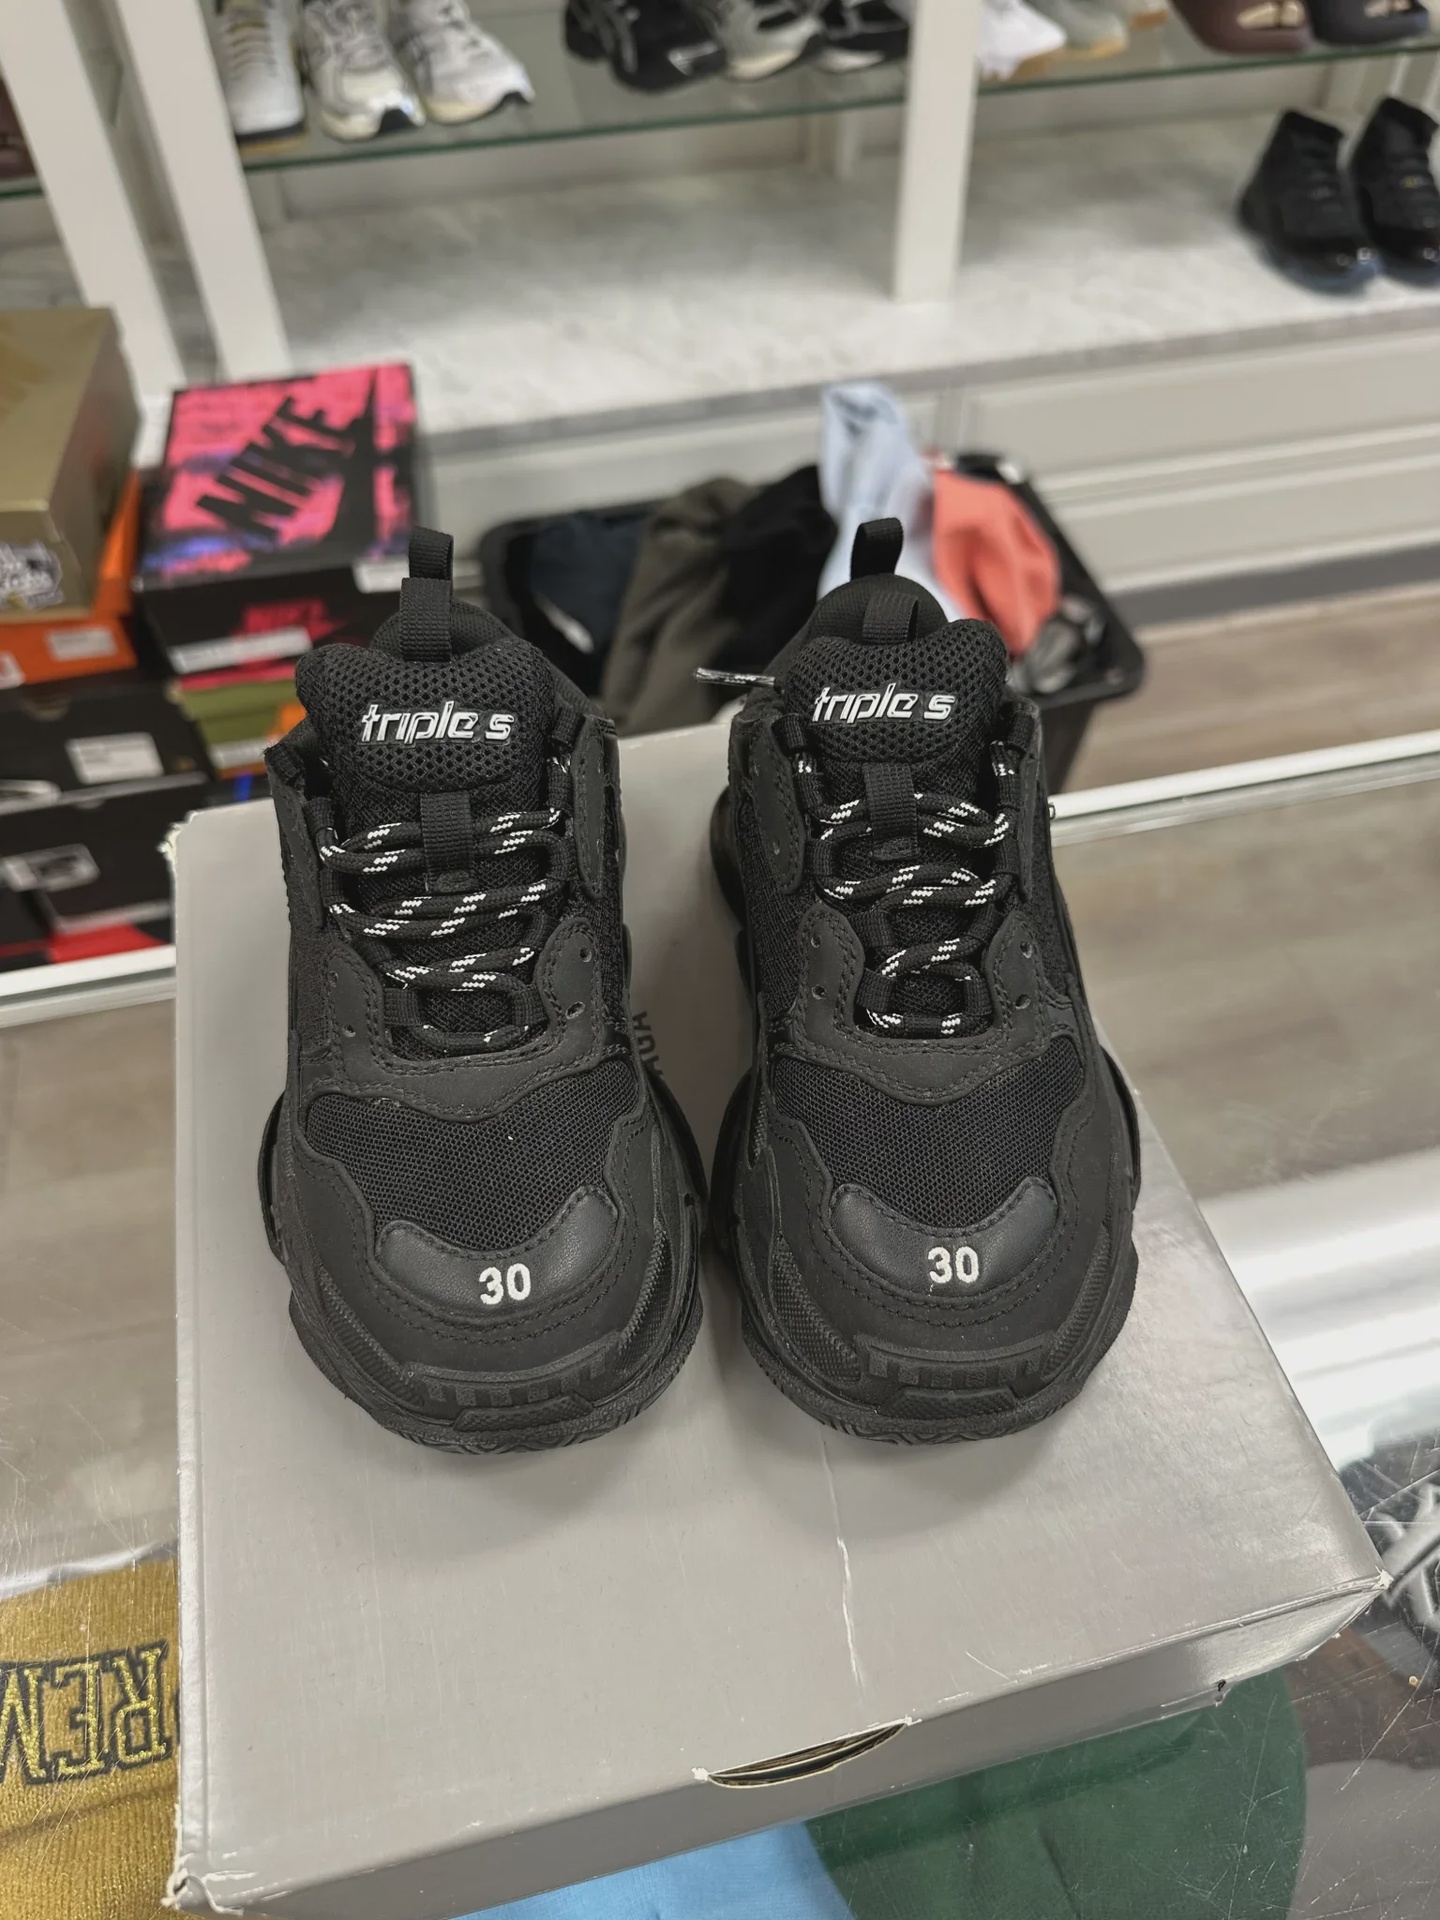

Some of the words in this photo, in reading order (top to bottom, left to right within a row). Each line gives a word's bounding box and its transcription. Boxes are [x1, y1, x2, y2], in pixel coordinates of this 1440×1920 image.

[196, 396, 353, 536] NIKE
[361, 701, 478, 743] triple
[485, 714, 515, 740] s
[812, 683, 919, 723] triple
[924, 695, 955, 720] s
[479, 1263, 531, 1304] 30
[928, 1246, 979, 1283] 30
[0, 1640, 178, 1785] REM
